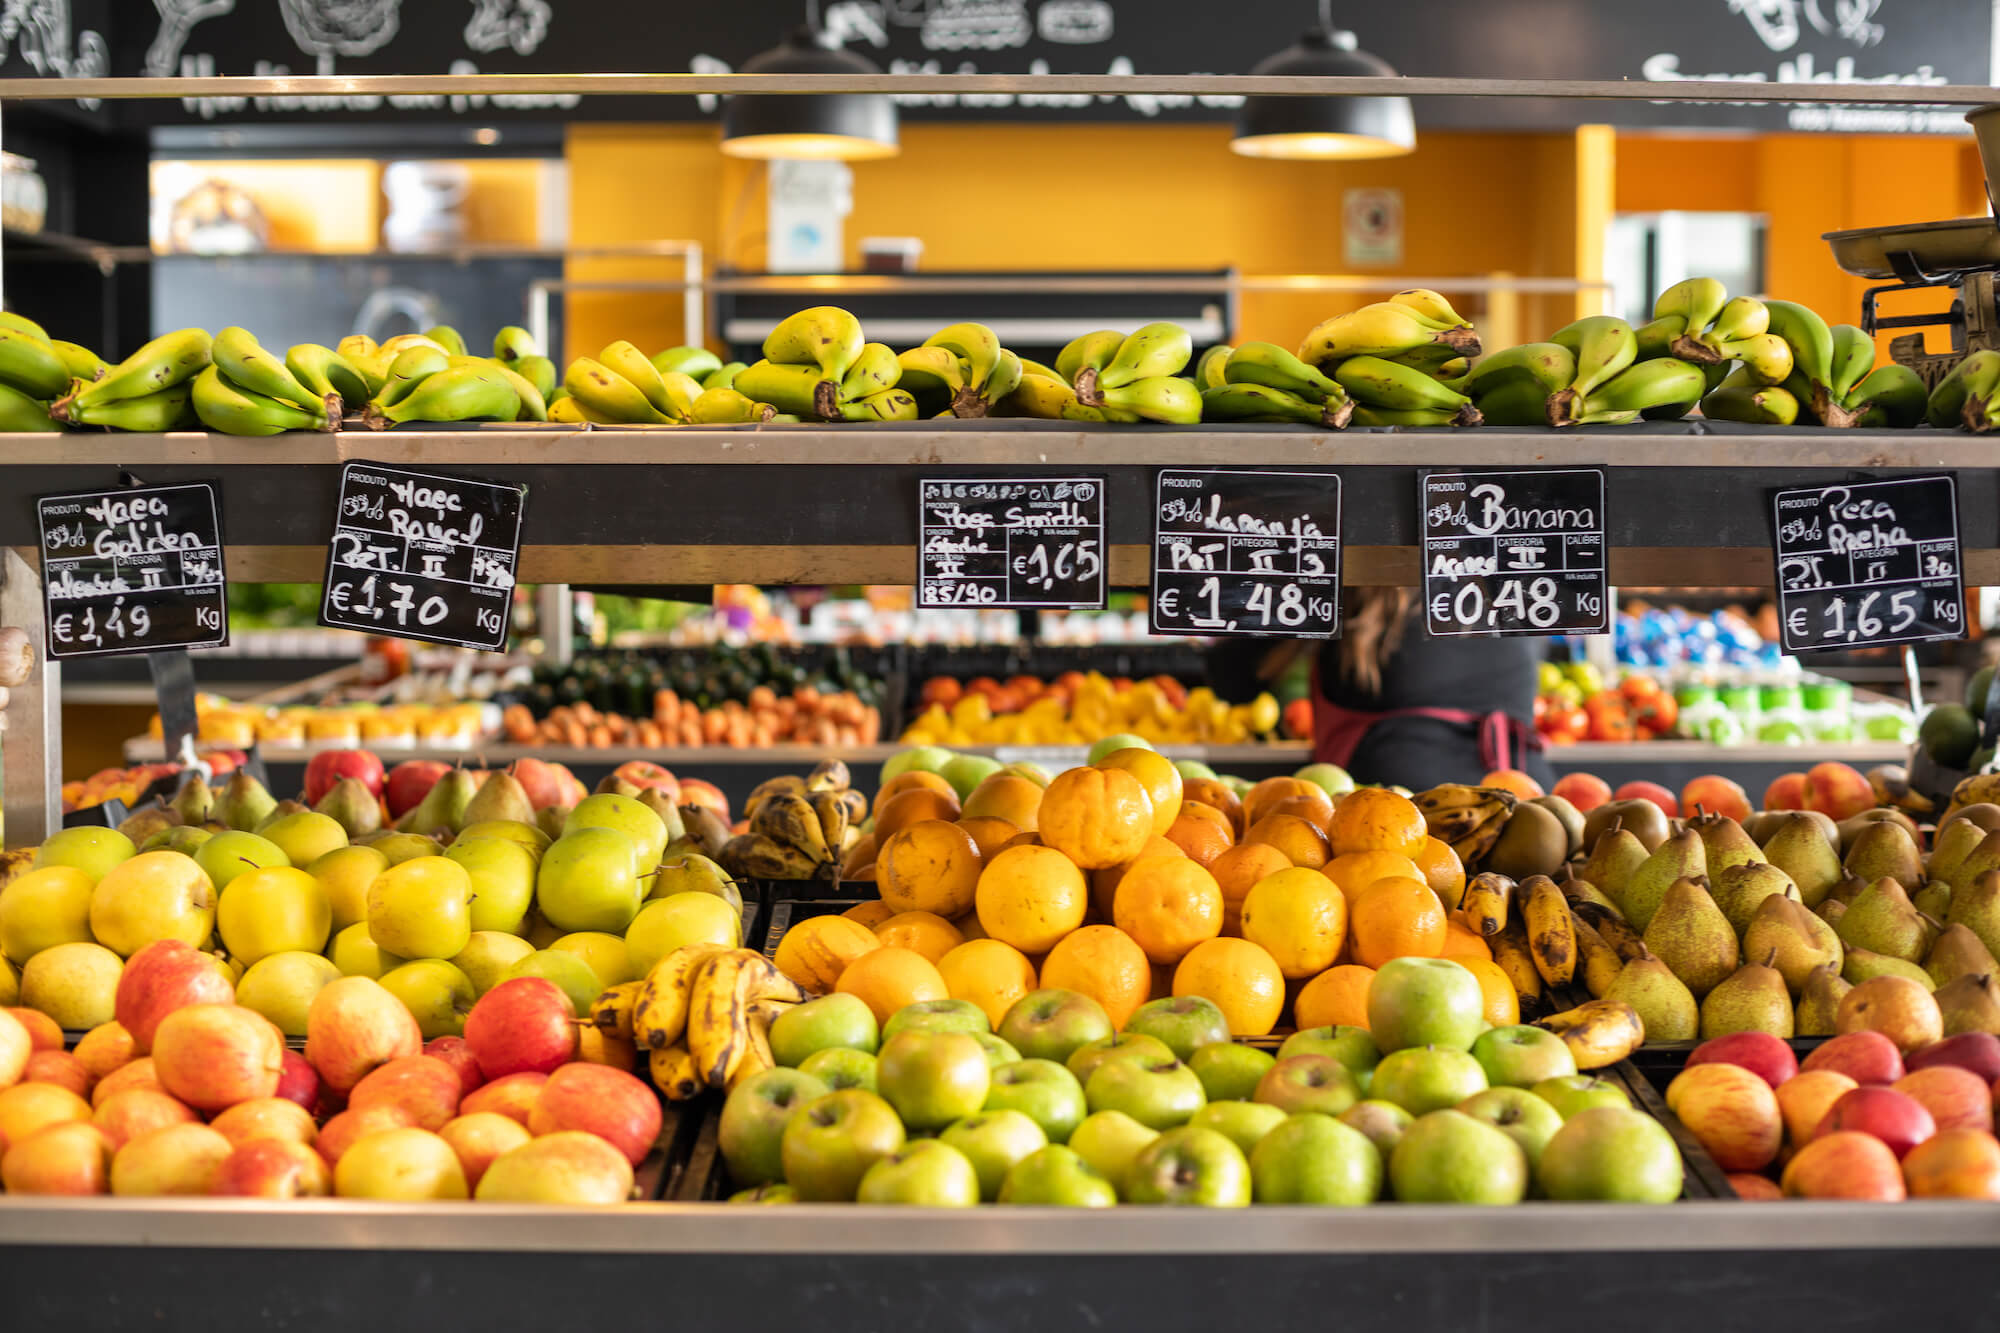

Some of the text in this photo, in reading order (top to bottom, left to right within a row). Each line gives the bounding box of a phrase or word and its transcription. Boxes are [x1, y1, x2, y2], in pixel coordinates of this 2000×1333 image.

[348, 472, 387, 486] PRODUTO
[1162, 478, 1203, 488] PRODUTO
[1428, 482, 1466, 492] PRODUTO
[42, 504, 81, 515] PRODUTO
[1466, 483, 1594, 535] Banana
[1779, 498, 1819, 509] PRODUTO
[1820, 486, 1896, 521] Pera
[94, 521, 203, 558] Golden
[1159, 537, 1336, 549] ORIGEM CATEGORIA CALIBRE
[1429, 536, 1601, 550] ORIGEM CATEGORIA CALIBRE
[1853, 542, 1955, 559] CATEGORIA CALIBRE
[49, 550, 217, 572] ORIGEM CATEGORIA CALIBRE
[478, 550, 512, 563] CALIBRE
[1248, 549, 1285, 574] II
[1302, 553, 1325, 577] 3
[1507, 546, 1547, 569] II
[924, 583, 998, 603] 85/90
[1576, 592, 1600, 616] Kg
[196, 607, 219, 630] Kg
[1308, 597, 1332, 622] Kg
[1933, 599, 1958, 623] Kg
[476, 608, 502, 634] Kg
